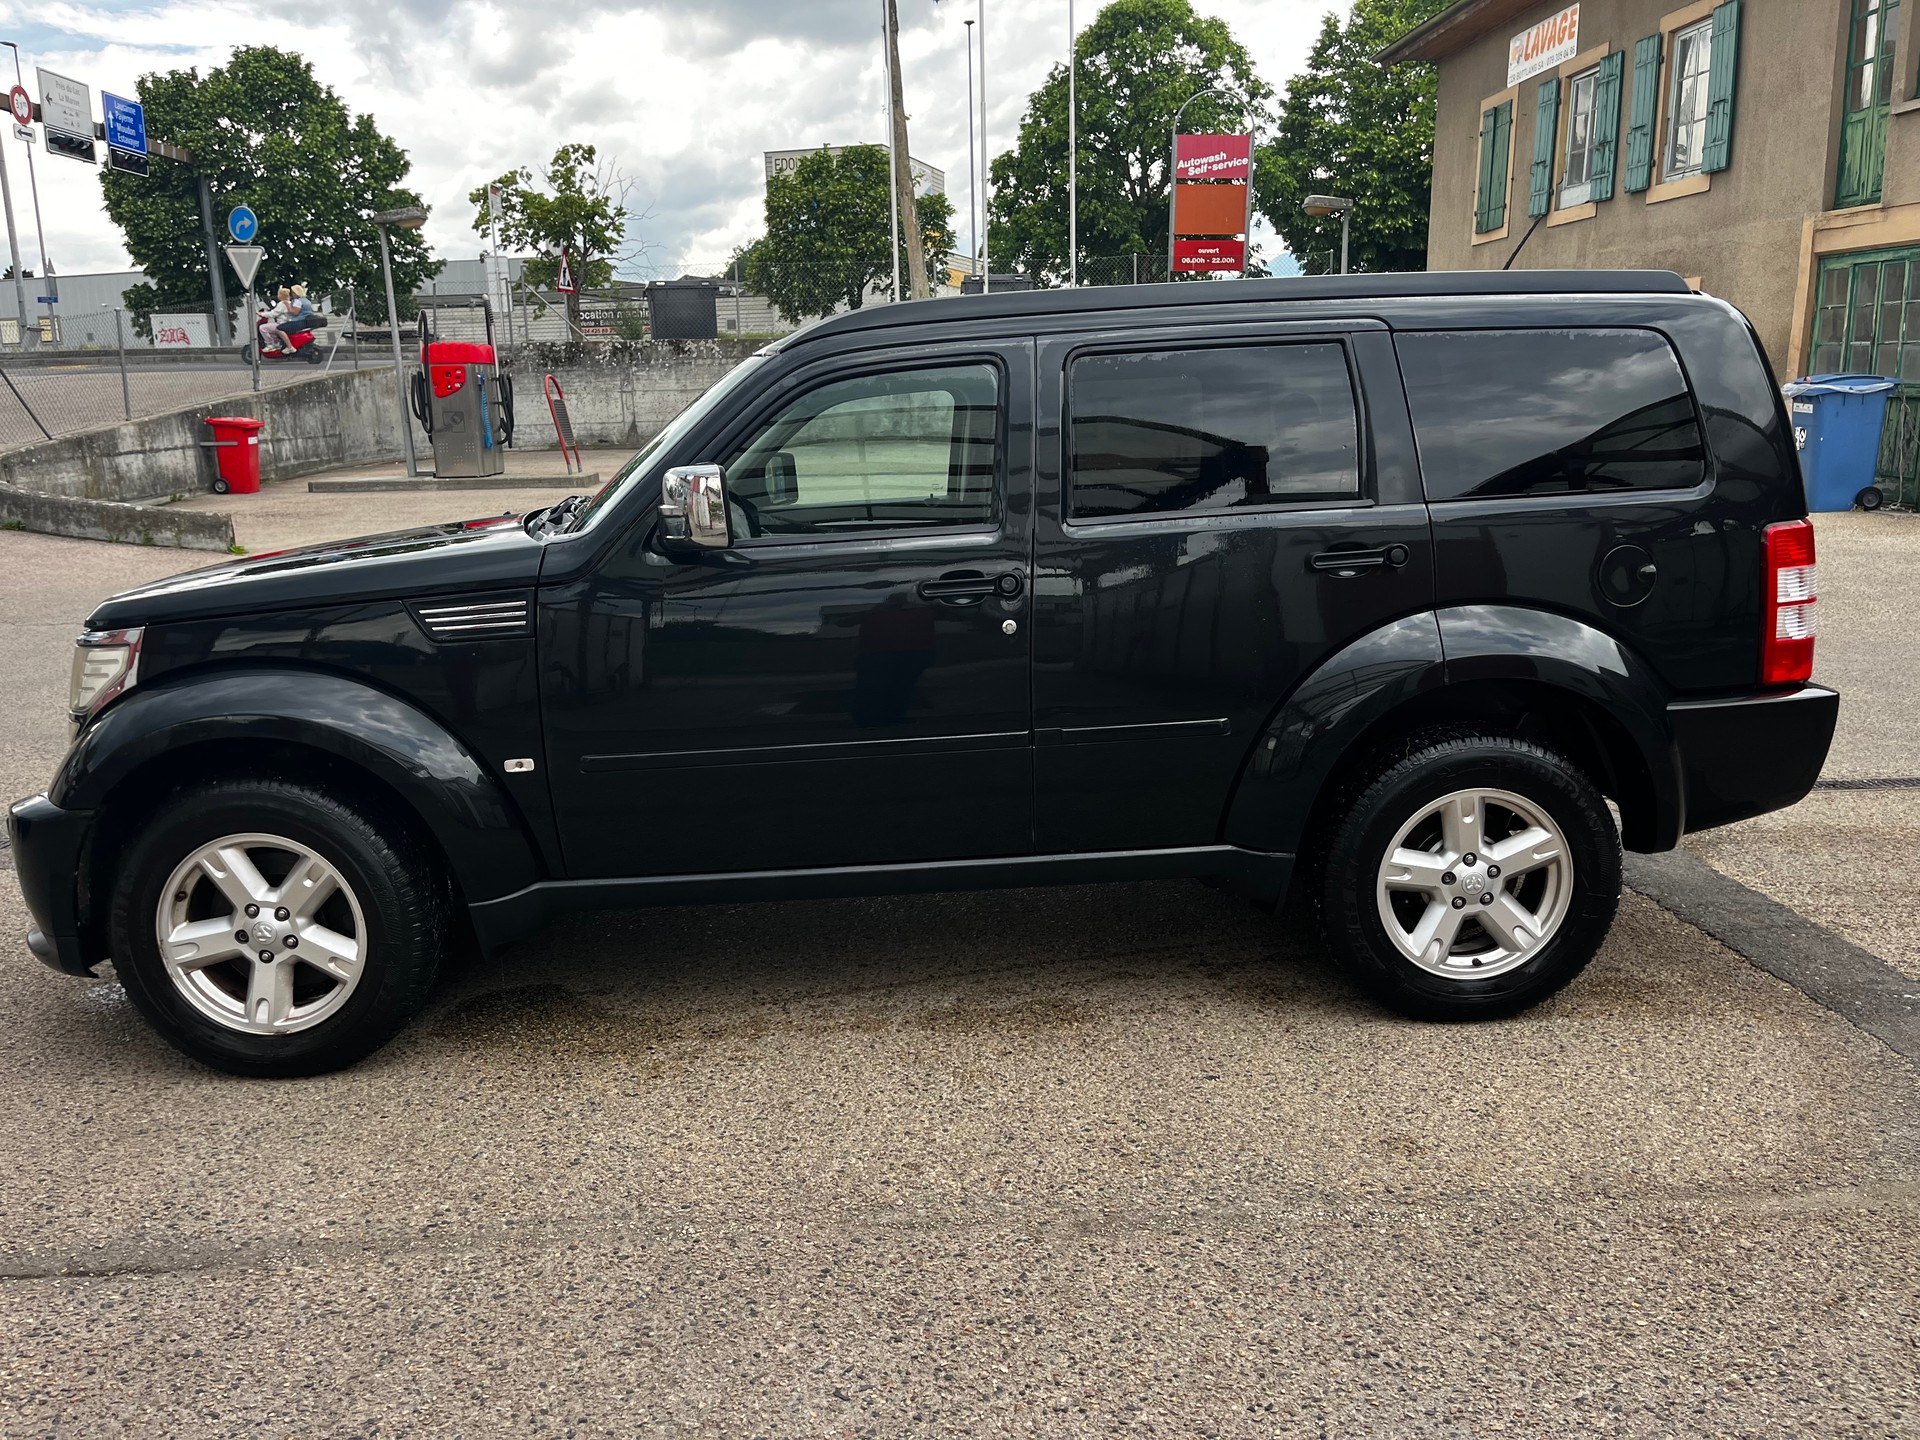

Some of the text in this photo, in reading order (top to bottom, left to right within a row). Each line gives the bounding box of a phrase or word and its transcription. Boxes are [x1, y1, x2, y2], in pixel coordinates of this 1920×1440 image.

[1523, 6, 1579, 62] LAVAGE
[1538, 60, 1544, 70] SA
[114, 100, 136, 116] Lausanne
[115, 110, 134, 125] Payerne
[116, 122, 136, 137] Moudon
[1177, 151, 1227, 170] Autowash
[1187, 157, 1249, 176] Self-service
[579, 309, 614, 320] ocation
